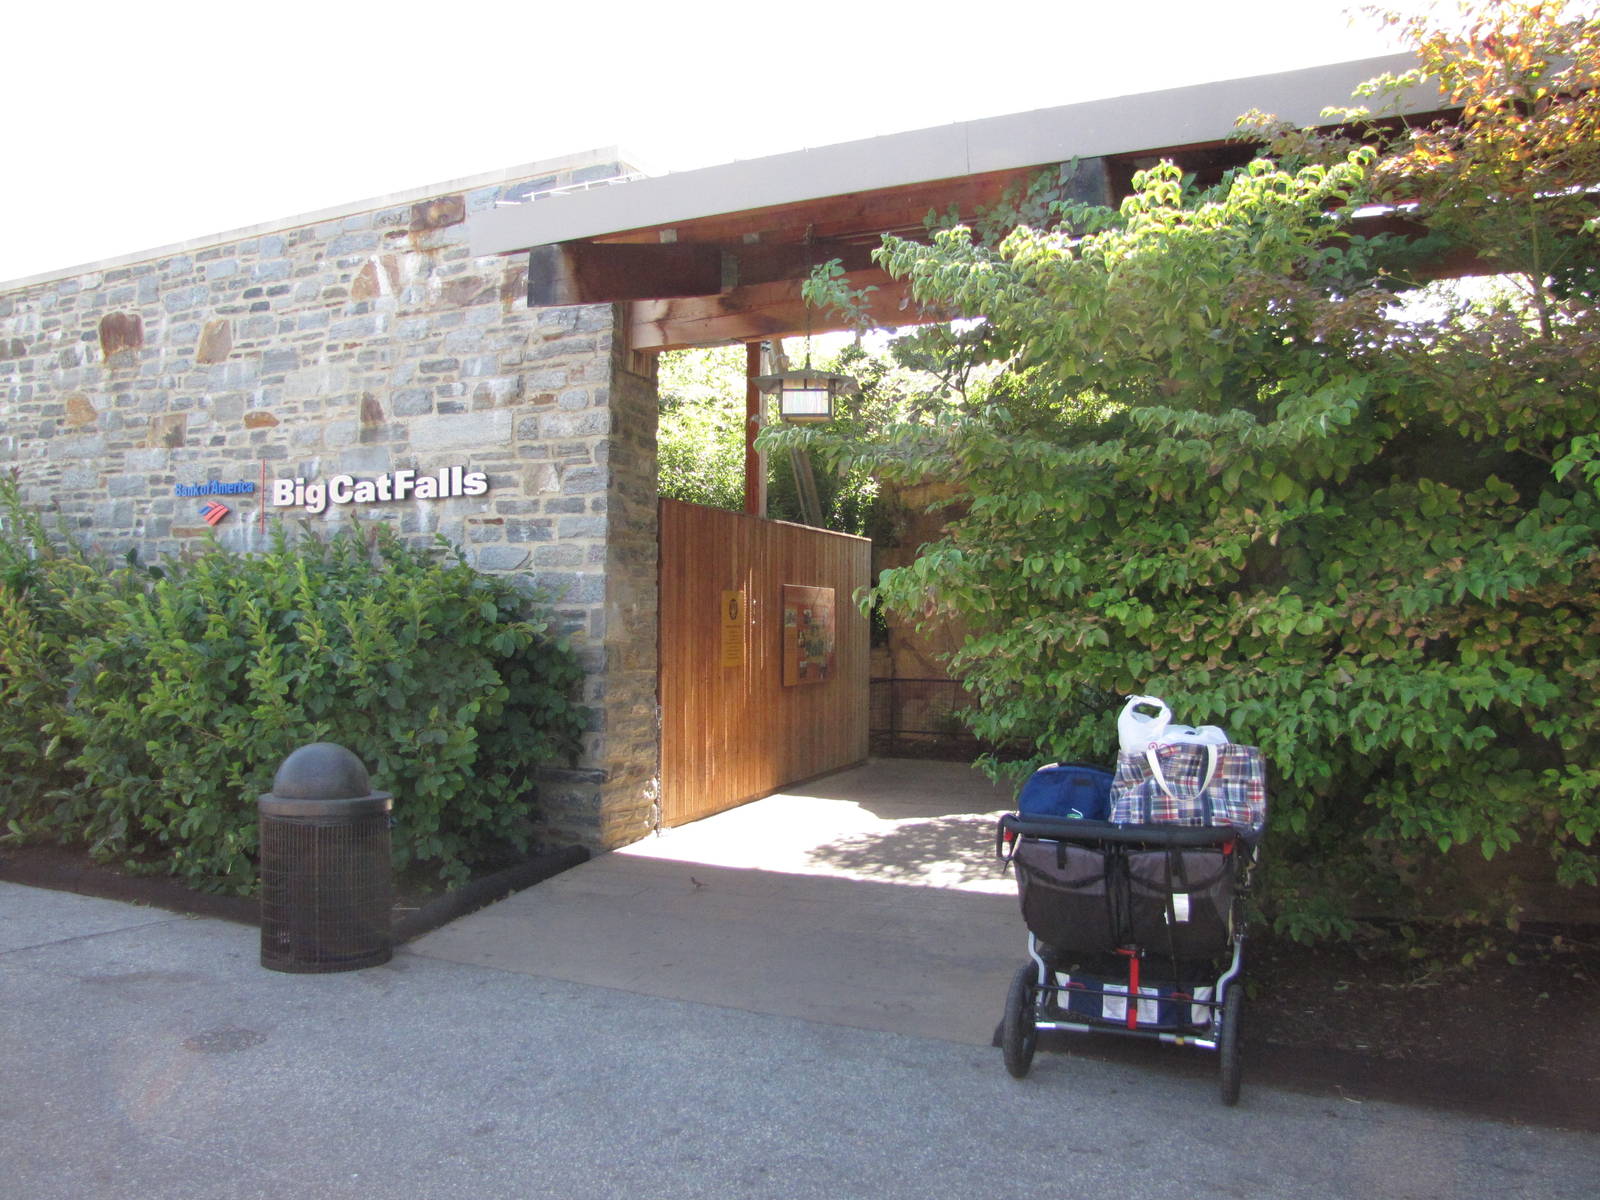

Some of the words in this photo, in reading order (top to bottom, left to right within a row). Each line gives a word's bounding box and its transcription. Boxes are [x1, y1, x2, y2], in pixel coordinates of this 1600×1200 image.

[175, 482, 200, 497] Bank
[210, 479, 255, 495] America
[273, 477, 326, 514] Big
[328, 473, 392, 504] Cat
[394, 465, 488, 500] Falls
